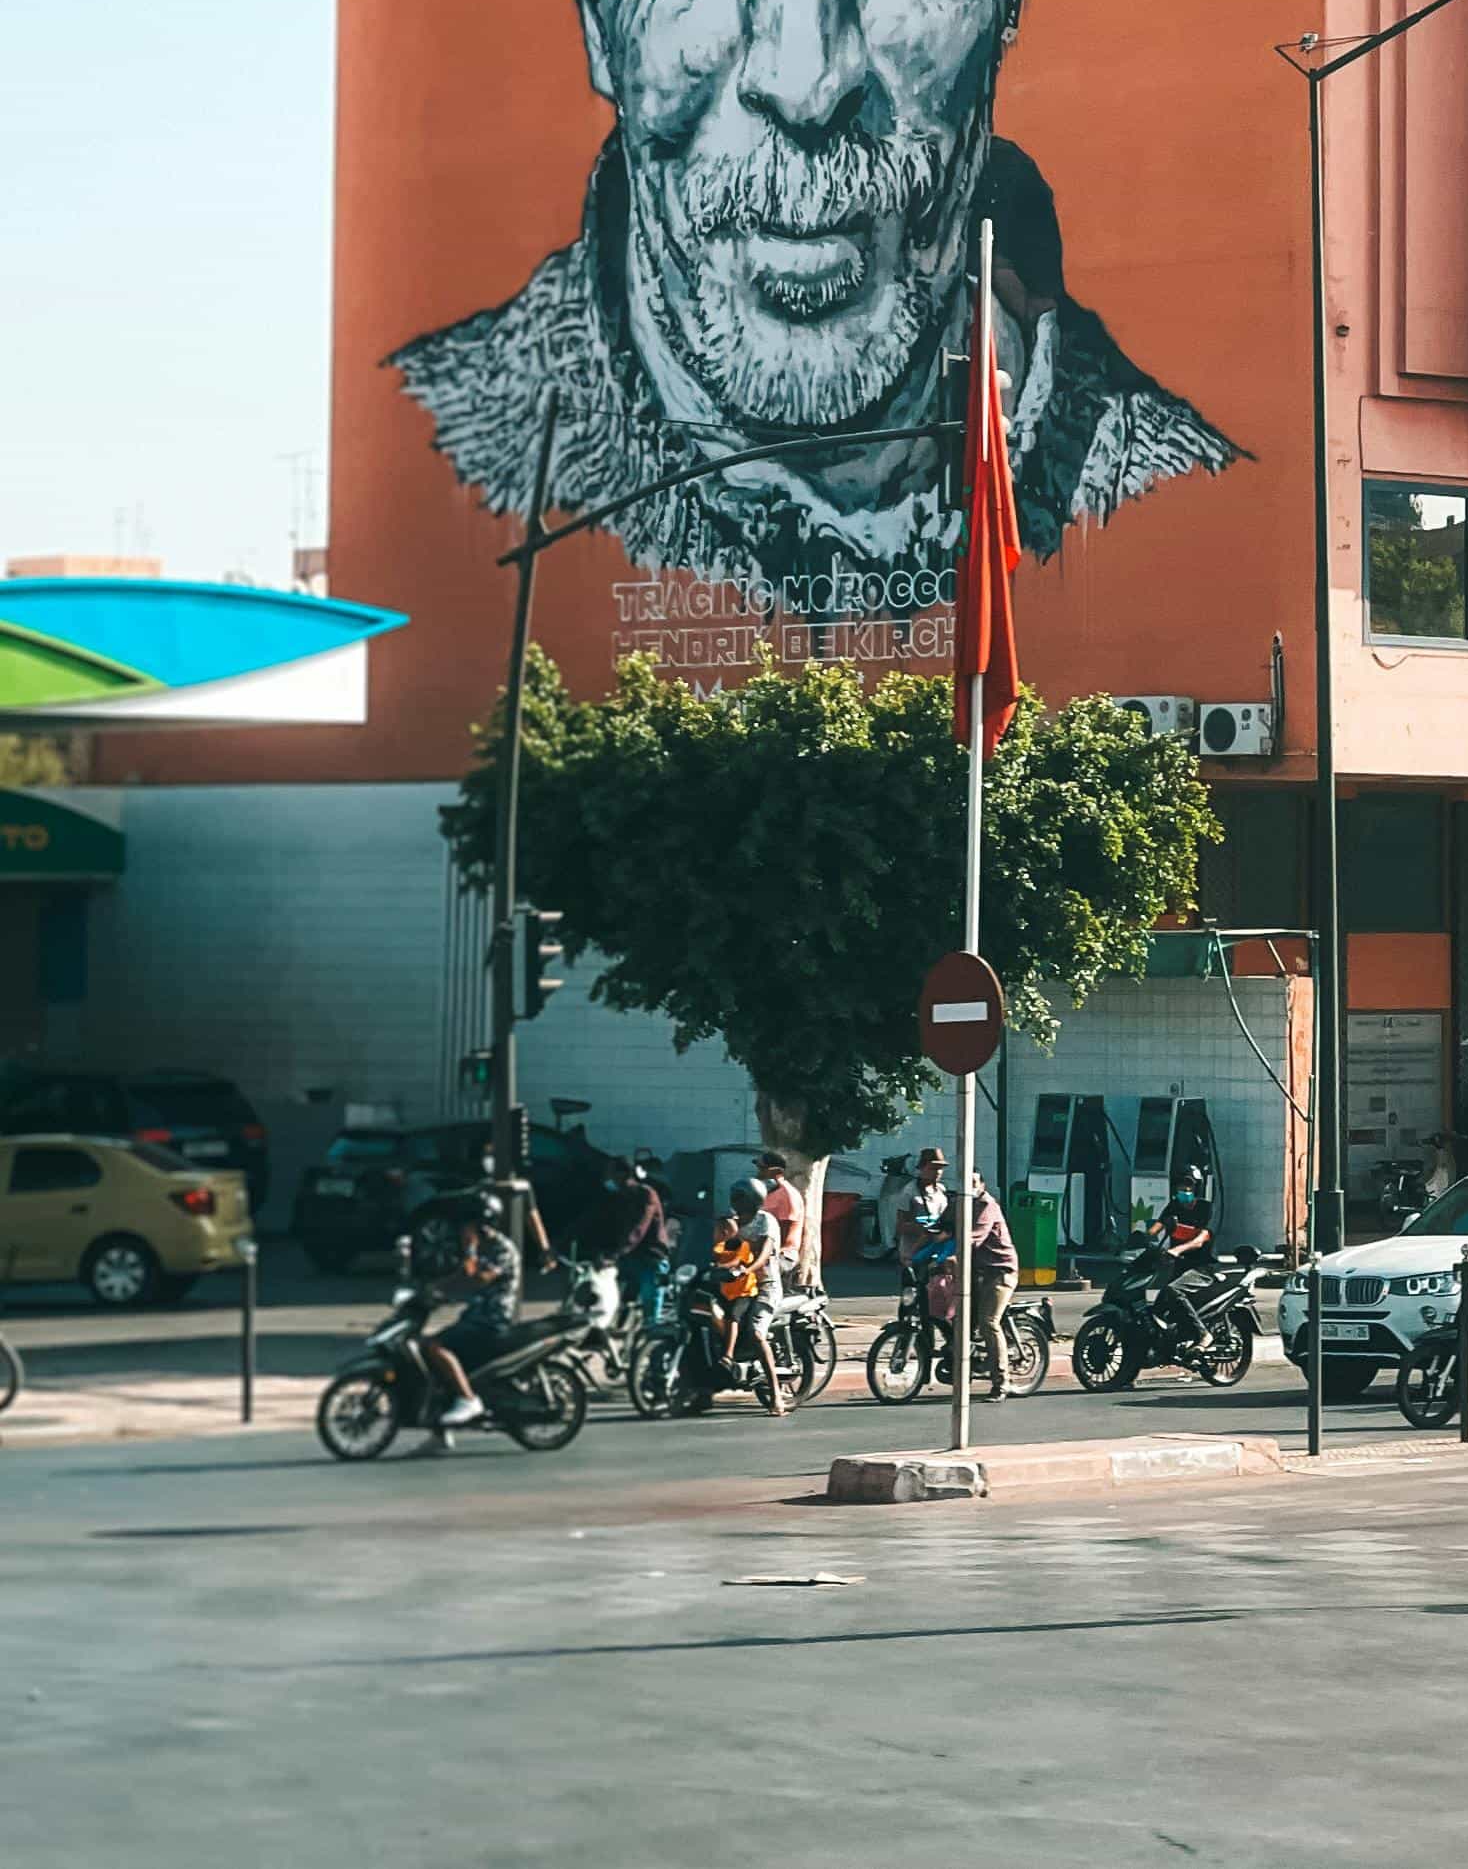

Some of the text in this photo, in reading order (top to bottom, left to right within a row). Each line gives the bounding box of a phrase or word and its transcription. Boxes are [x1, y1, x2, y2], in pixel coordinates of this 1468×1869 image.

[612, 568, 958, 622] TRACING MOROCCO
[611, 617, 957, 669] HENDRIK BEIKIRCH
